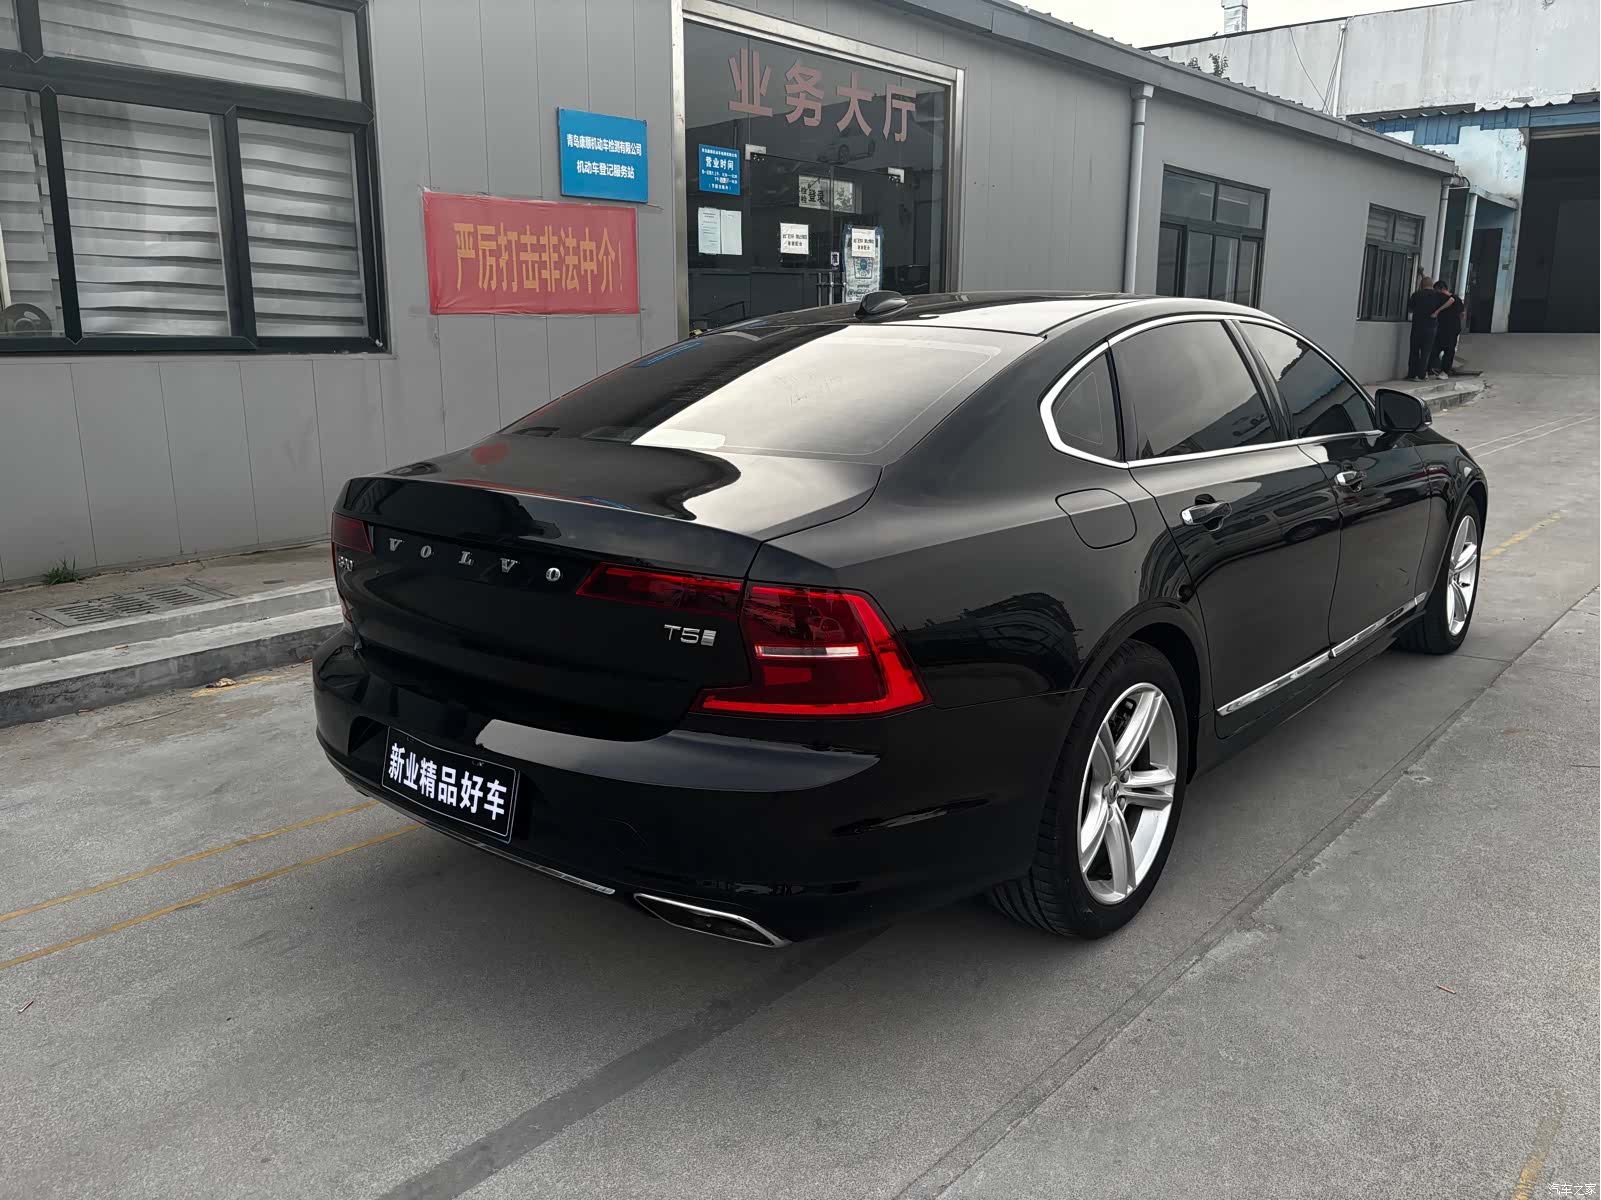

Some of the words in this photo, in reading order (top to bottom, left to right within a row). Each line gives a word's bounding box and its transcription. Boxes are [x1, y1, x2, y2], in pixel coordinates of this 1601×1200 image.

[727, 47, 917, 142] 业务大厅
[566, 133, 642, 157] 青岛康顺机动车检测有限公司
[576, 159, 635, 180] 机动车登记服务站
[705, 156, 734, 171] 营业时间
[808, 188, 825, 203] 登录
[388, 538, 562, 583] VOLVO
[663, 624, 700, 644] T5
[388, 742, 508, 821] 新业精品好车
